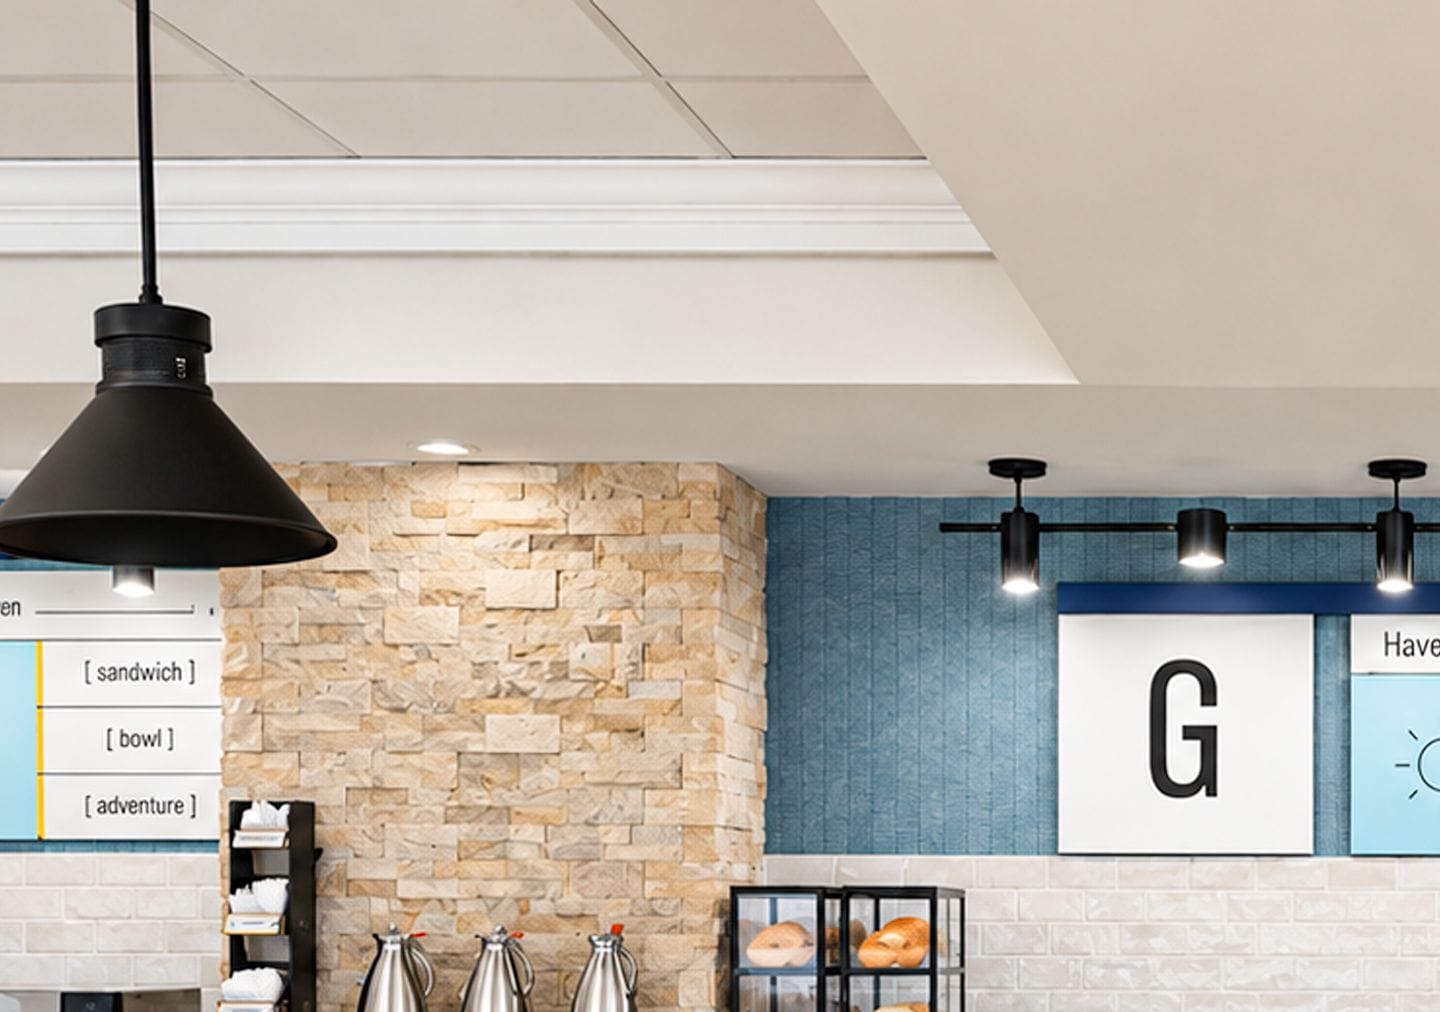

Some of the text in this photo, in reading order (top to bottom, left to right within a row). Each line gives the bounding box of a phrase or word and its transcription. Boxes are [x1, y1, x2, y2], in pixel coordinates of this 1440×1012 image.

[97, 661, 182, 682] sandwich
[119, 728, 162, 748] bowl
[1149, 659, 1218, 799] G
[96, 795, 185, 815] adventure
